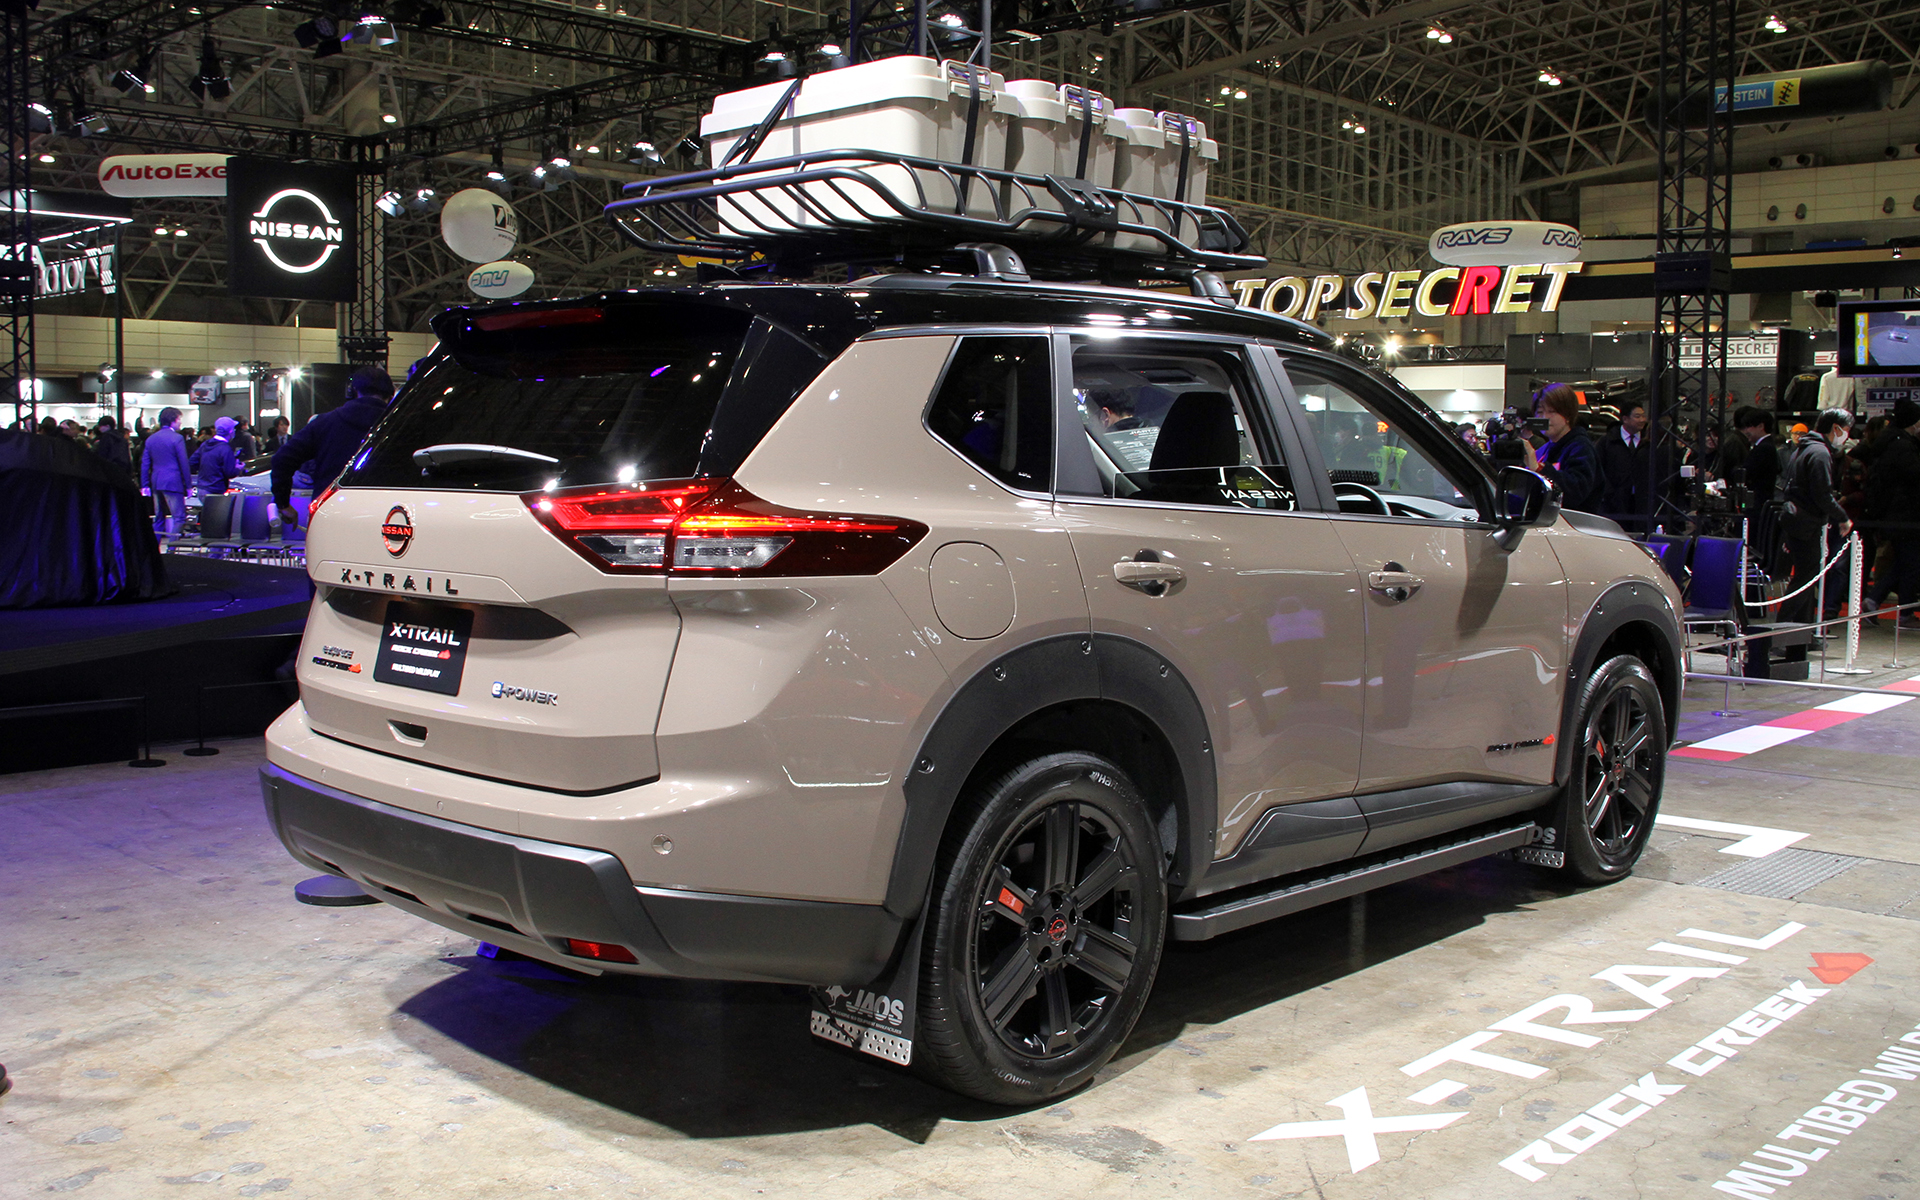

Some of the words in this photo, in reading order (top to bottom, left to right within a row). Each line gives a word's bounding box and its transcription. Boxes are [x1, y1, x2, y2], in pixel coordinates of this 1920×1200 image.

[250, 220, 343, 242] NISSAN
[1437, 227, 1513, 249] RAYS
[1543, 228, 1582, 249] RAY
[1233, 274, 1344, 321] TOP
[1345, 262, 1584, 320] SECRET
[1727, 342, 1777, 355] SECRET
[1871, 391, 1908, 400] TOP
[381, 525, 412, 536] NISSAN
[340, 568, 459, 595] X-TRAIL
[389, 622, 461, 647] X-TRAIL
[491, 681, 558, 706] e-POWER
[846, 989, 905, 1027] JAOS
[1246, 920, 1808, 1175] X-TRAIL
[1497, 1071, 1687, 1183] ROCK
[1666, 979, 1832, 1077] CREEK
[1711, 1079, 1898, 1200] MULTIBED
